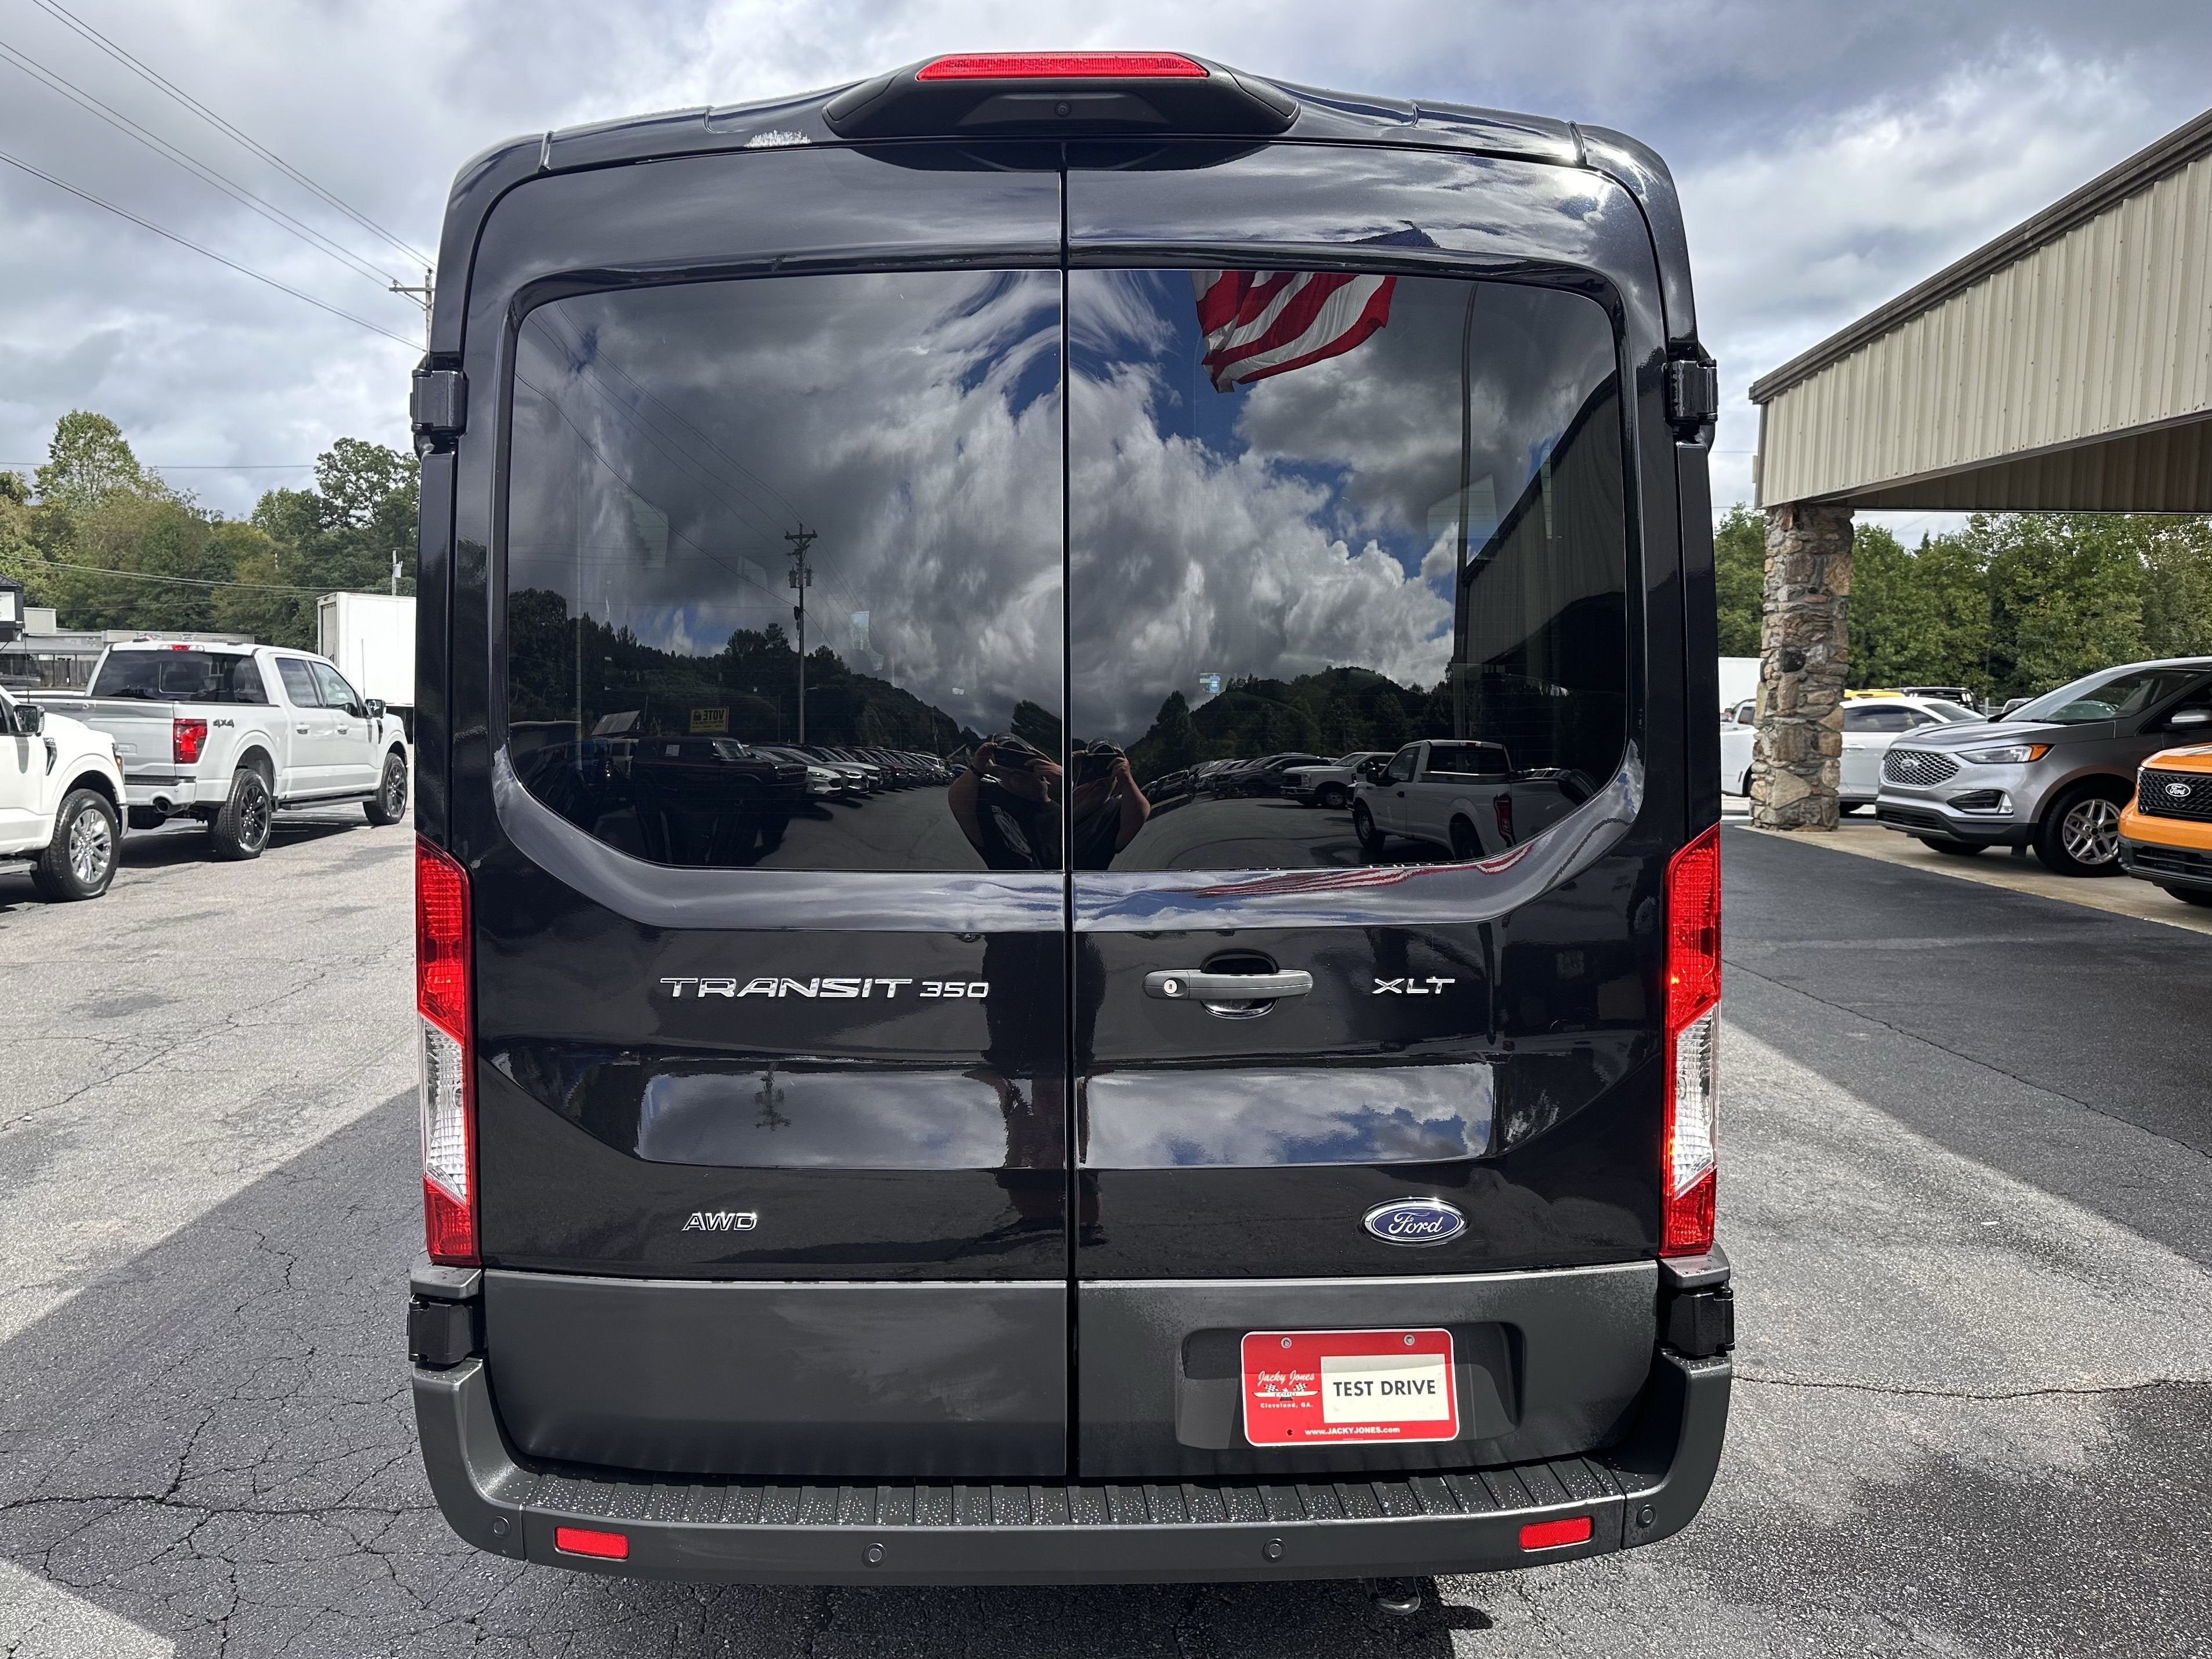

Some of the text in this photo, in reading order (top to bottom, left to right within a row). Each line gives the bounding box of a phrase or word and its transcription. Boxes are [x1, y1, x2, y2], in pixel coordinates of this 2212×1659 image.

[2170, 785, 2185, 795] Ford
[660, 977, 989, 998] TRANSIT 350
[1372, 977, 1456, 994] XLT
[681, 1212, 757, 1231] AWD
[1388, 1212, 1444, 1234] Ford
[1257, 1370, 1315, 1386] Jacky Jones
[1333, 1379, 1436, 1397] TEST DRIVE
[1304, 1426, 1401, 1435] www.JACKYJONES.com
